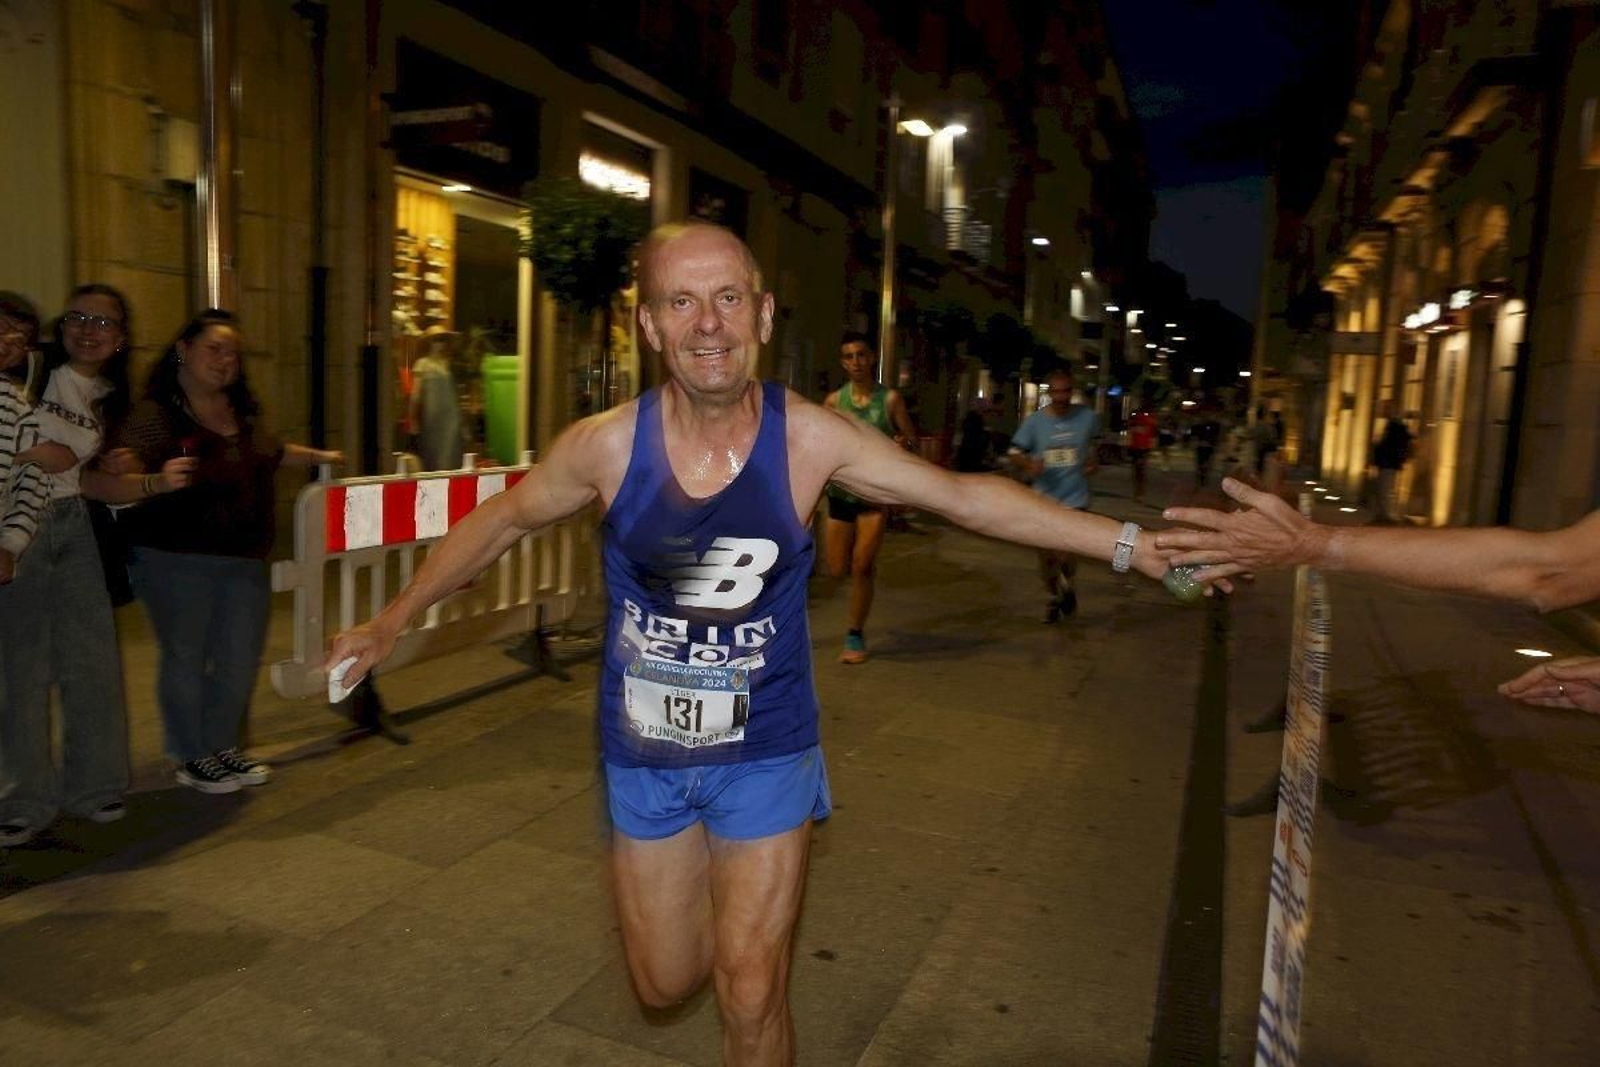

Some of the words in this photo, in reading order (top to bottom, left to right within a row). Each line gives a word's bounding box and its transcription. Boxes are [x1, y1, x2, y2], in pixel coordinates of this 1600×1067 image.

[702, 678, 726, 688] 2024
[664, 695, 703, 732] 131
[648, 725, 720, 746] PUNGINSPORT
